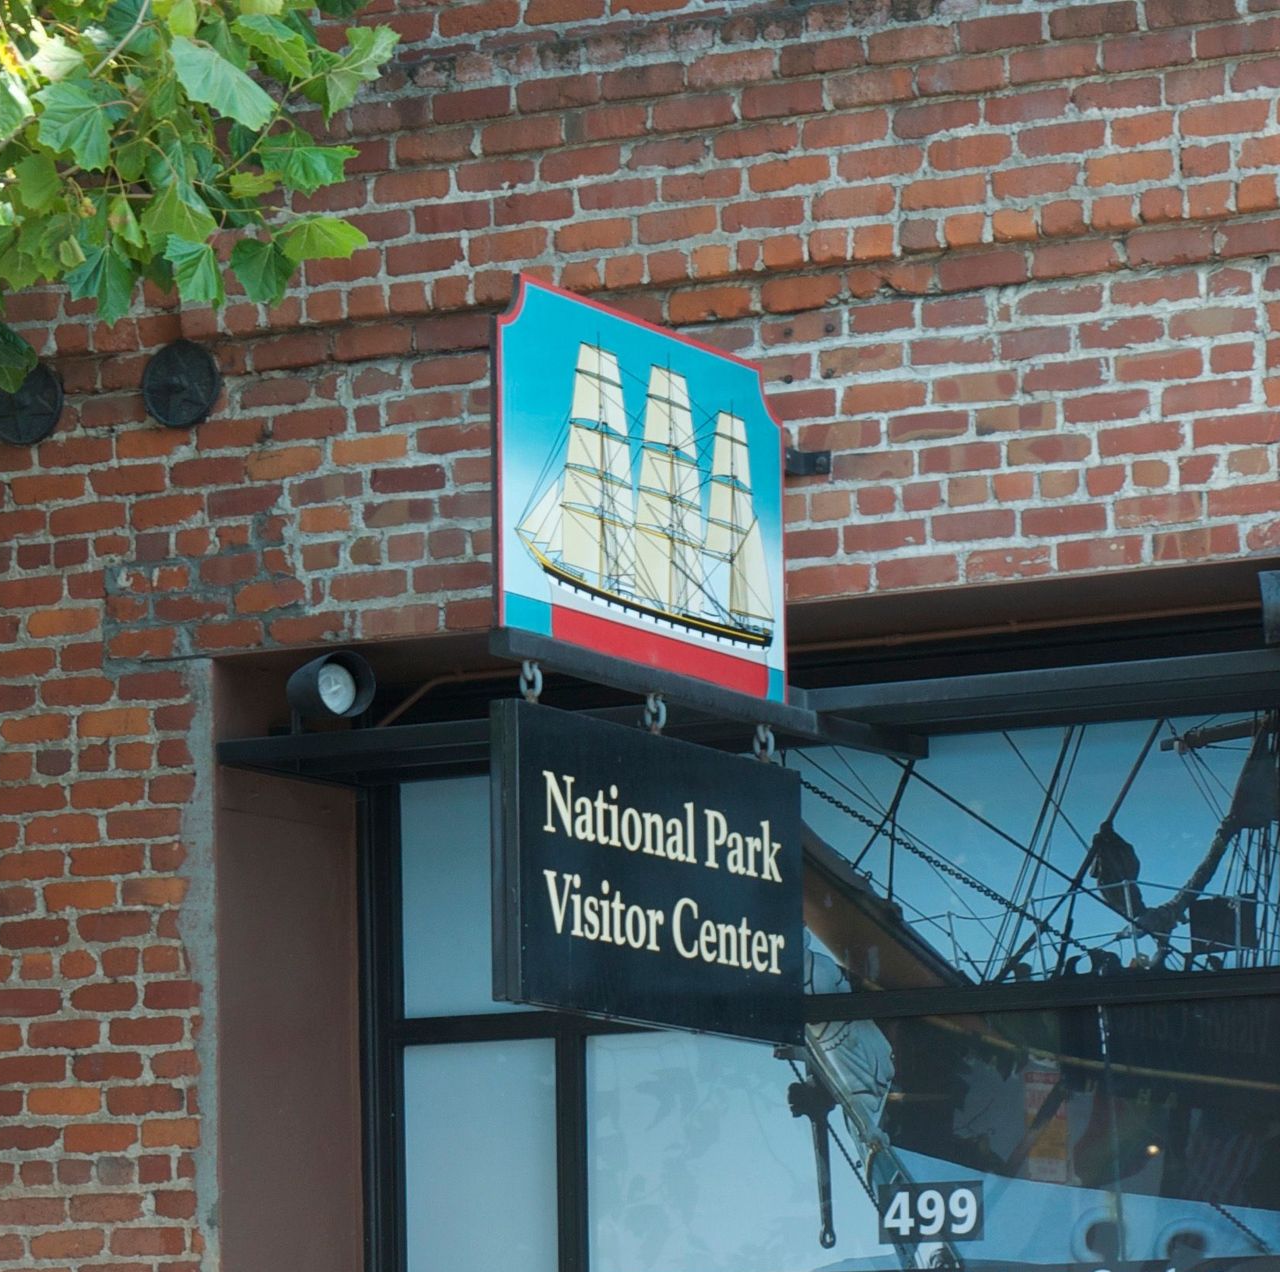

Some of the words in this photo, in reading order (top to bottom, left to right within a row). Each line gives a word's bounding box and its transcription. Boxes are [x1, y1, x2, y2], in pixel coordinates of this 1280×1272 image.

[543, 770, 697, 867] National
[705, 805, 782, 884] Park
[543, 869, 665, 954] Visitor
[672, 897, 785, 976] Center
[882, 1187, 978, 1237] 499
